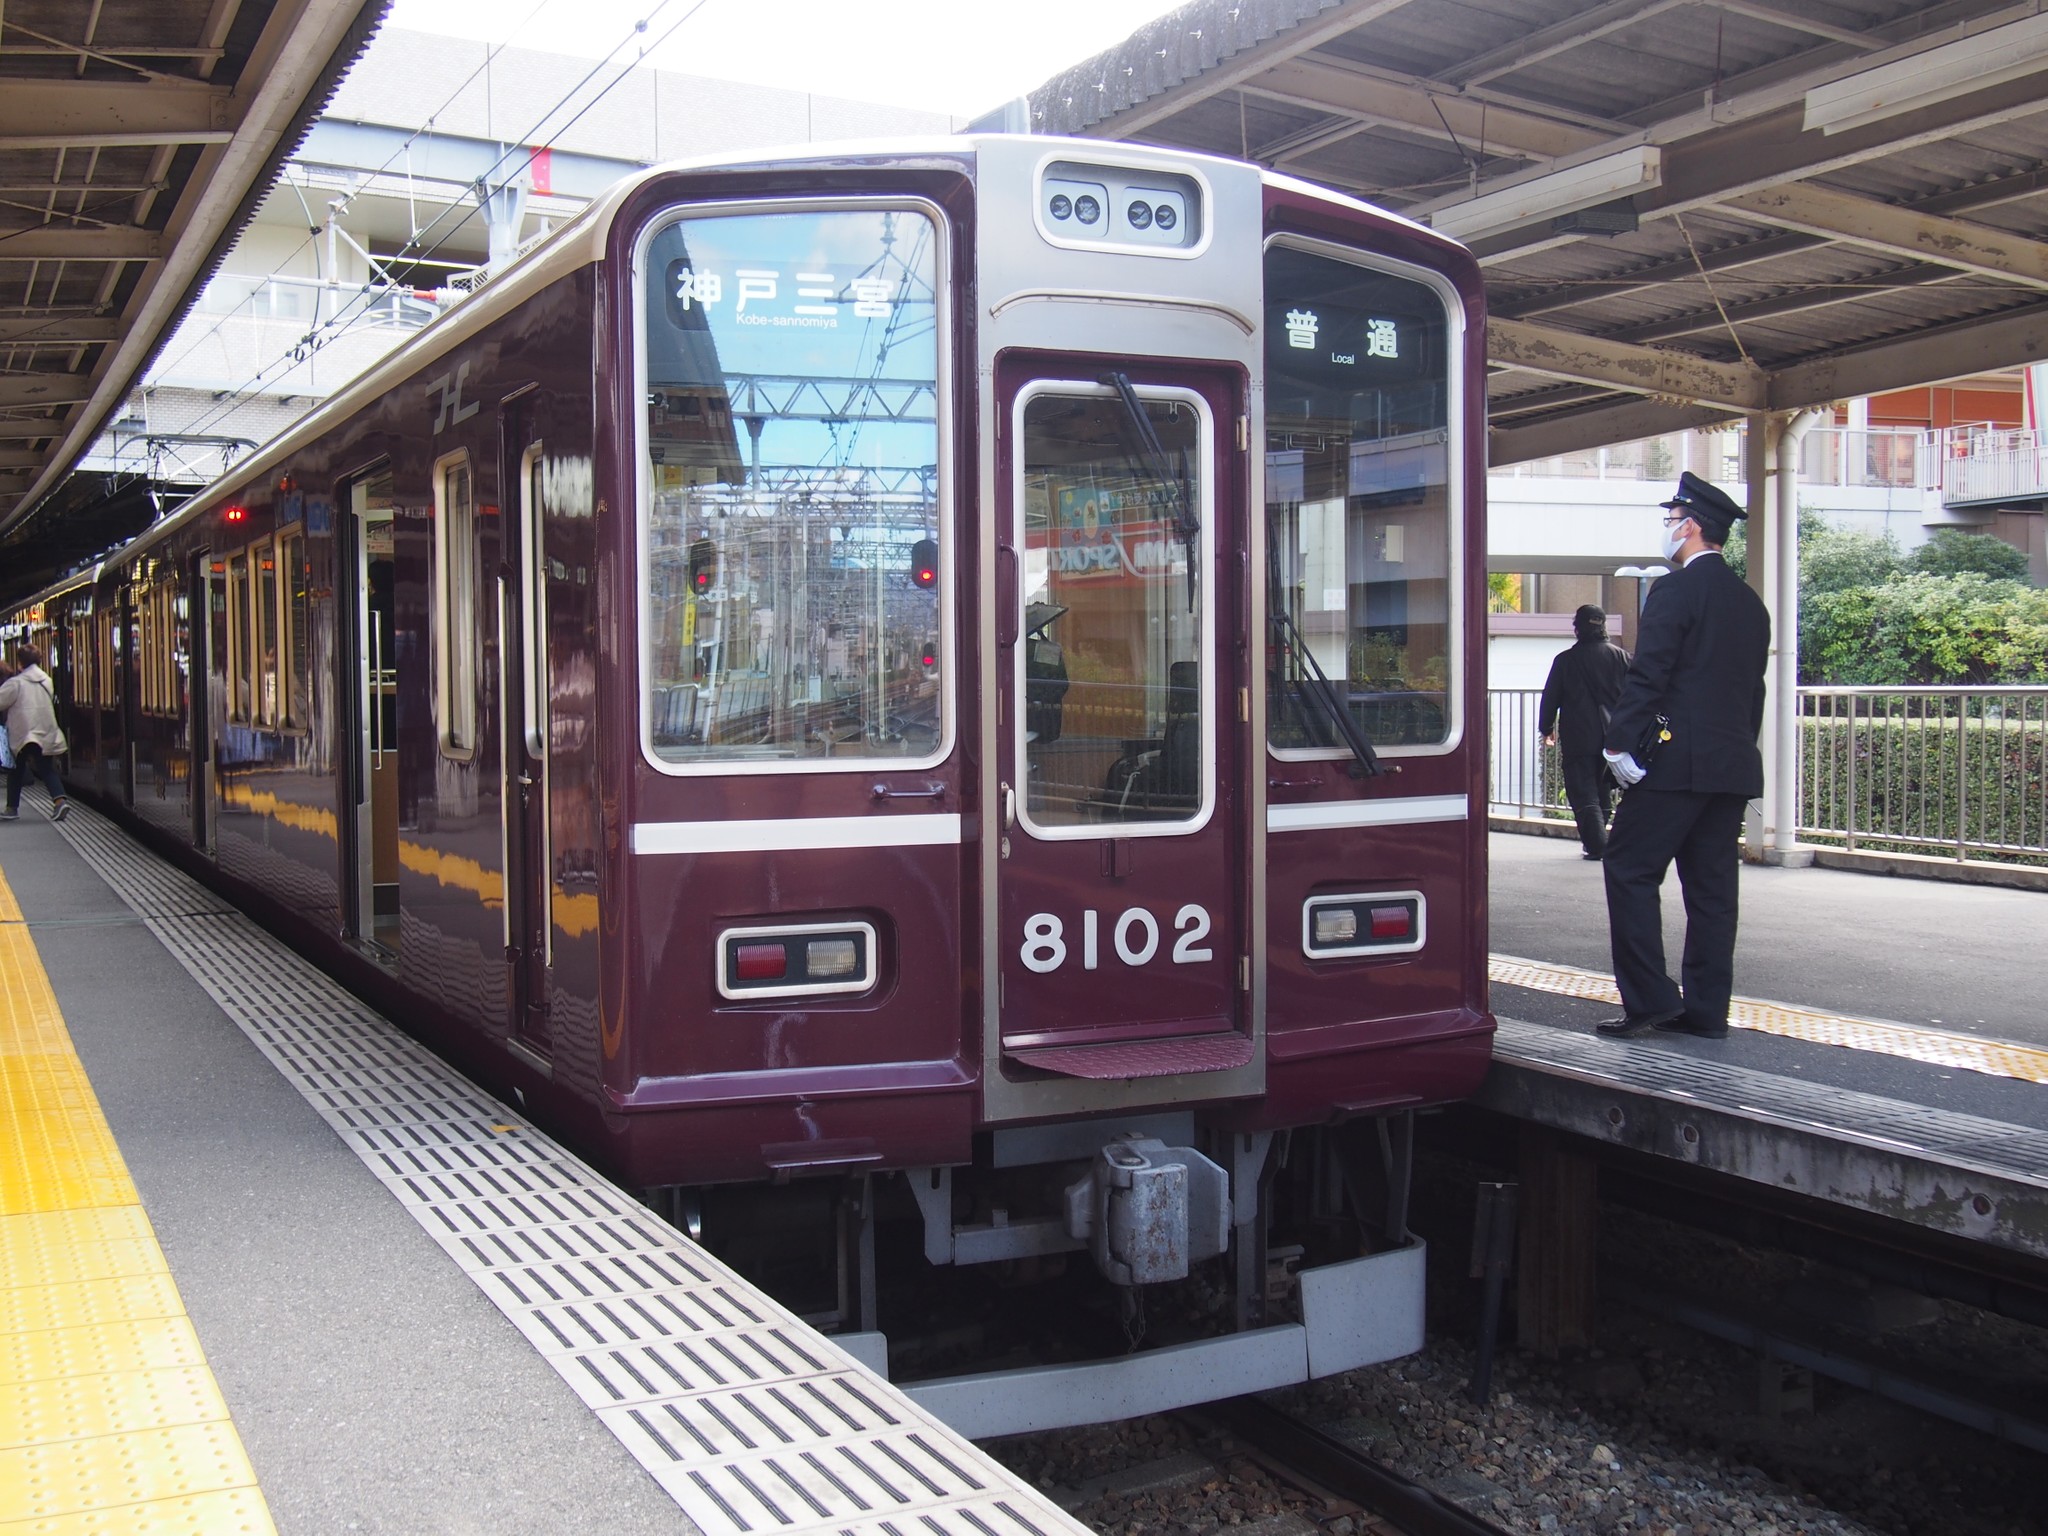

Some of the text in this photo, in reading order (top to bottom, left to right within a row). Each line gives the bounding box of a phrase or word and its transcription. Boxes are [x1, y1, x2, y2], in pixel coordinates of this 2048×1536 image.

[677, 267, 894, 318] 神戸三宮
[736, 312, 838, 329] Kobe-sannomiya
[1286, 309, 1398, 358] 普通
[1331, 352, 1355, 365] Local
[1020, 903, 1213, 974] 8102
